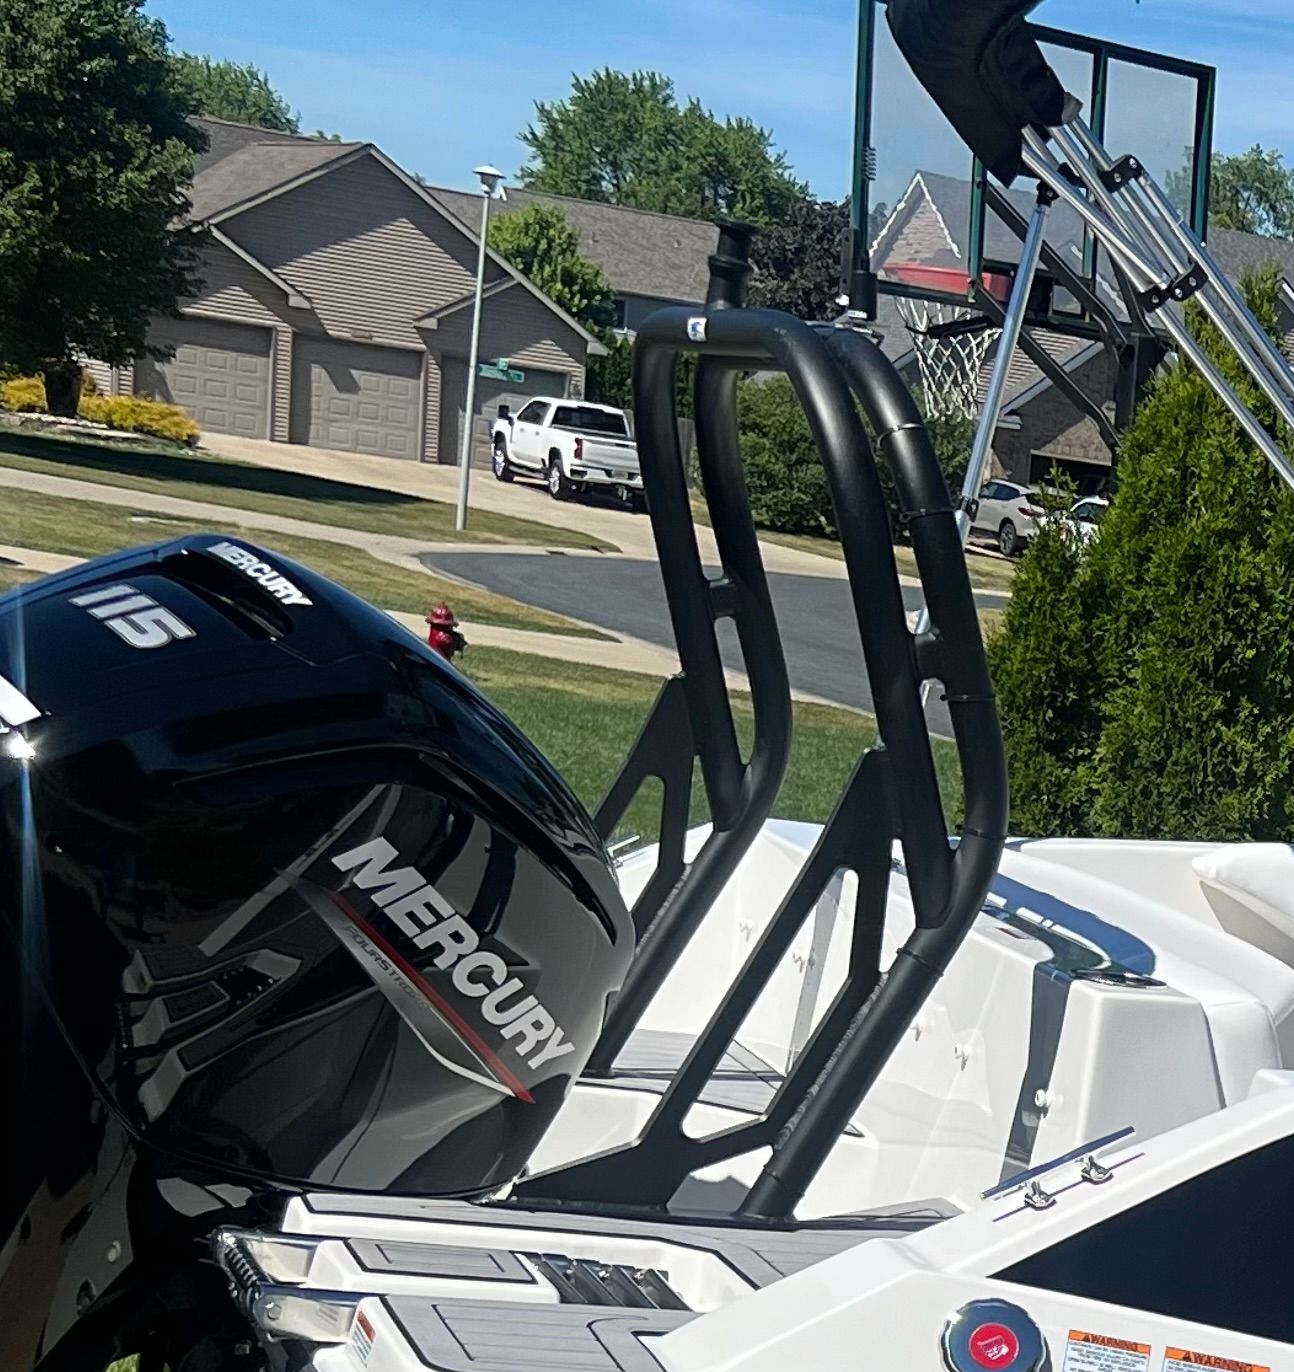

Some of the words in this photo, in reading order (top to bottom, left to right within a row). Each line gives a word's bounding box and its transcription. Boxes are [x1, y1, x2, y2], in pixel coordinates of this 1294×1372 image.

[206, 541, 313, 606] MERCURY
[70, 584, 197, 649] 115
[331, 836, 575, 1070] MERCURY
